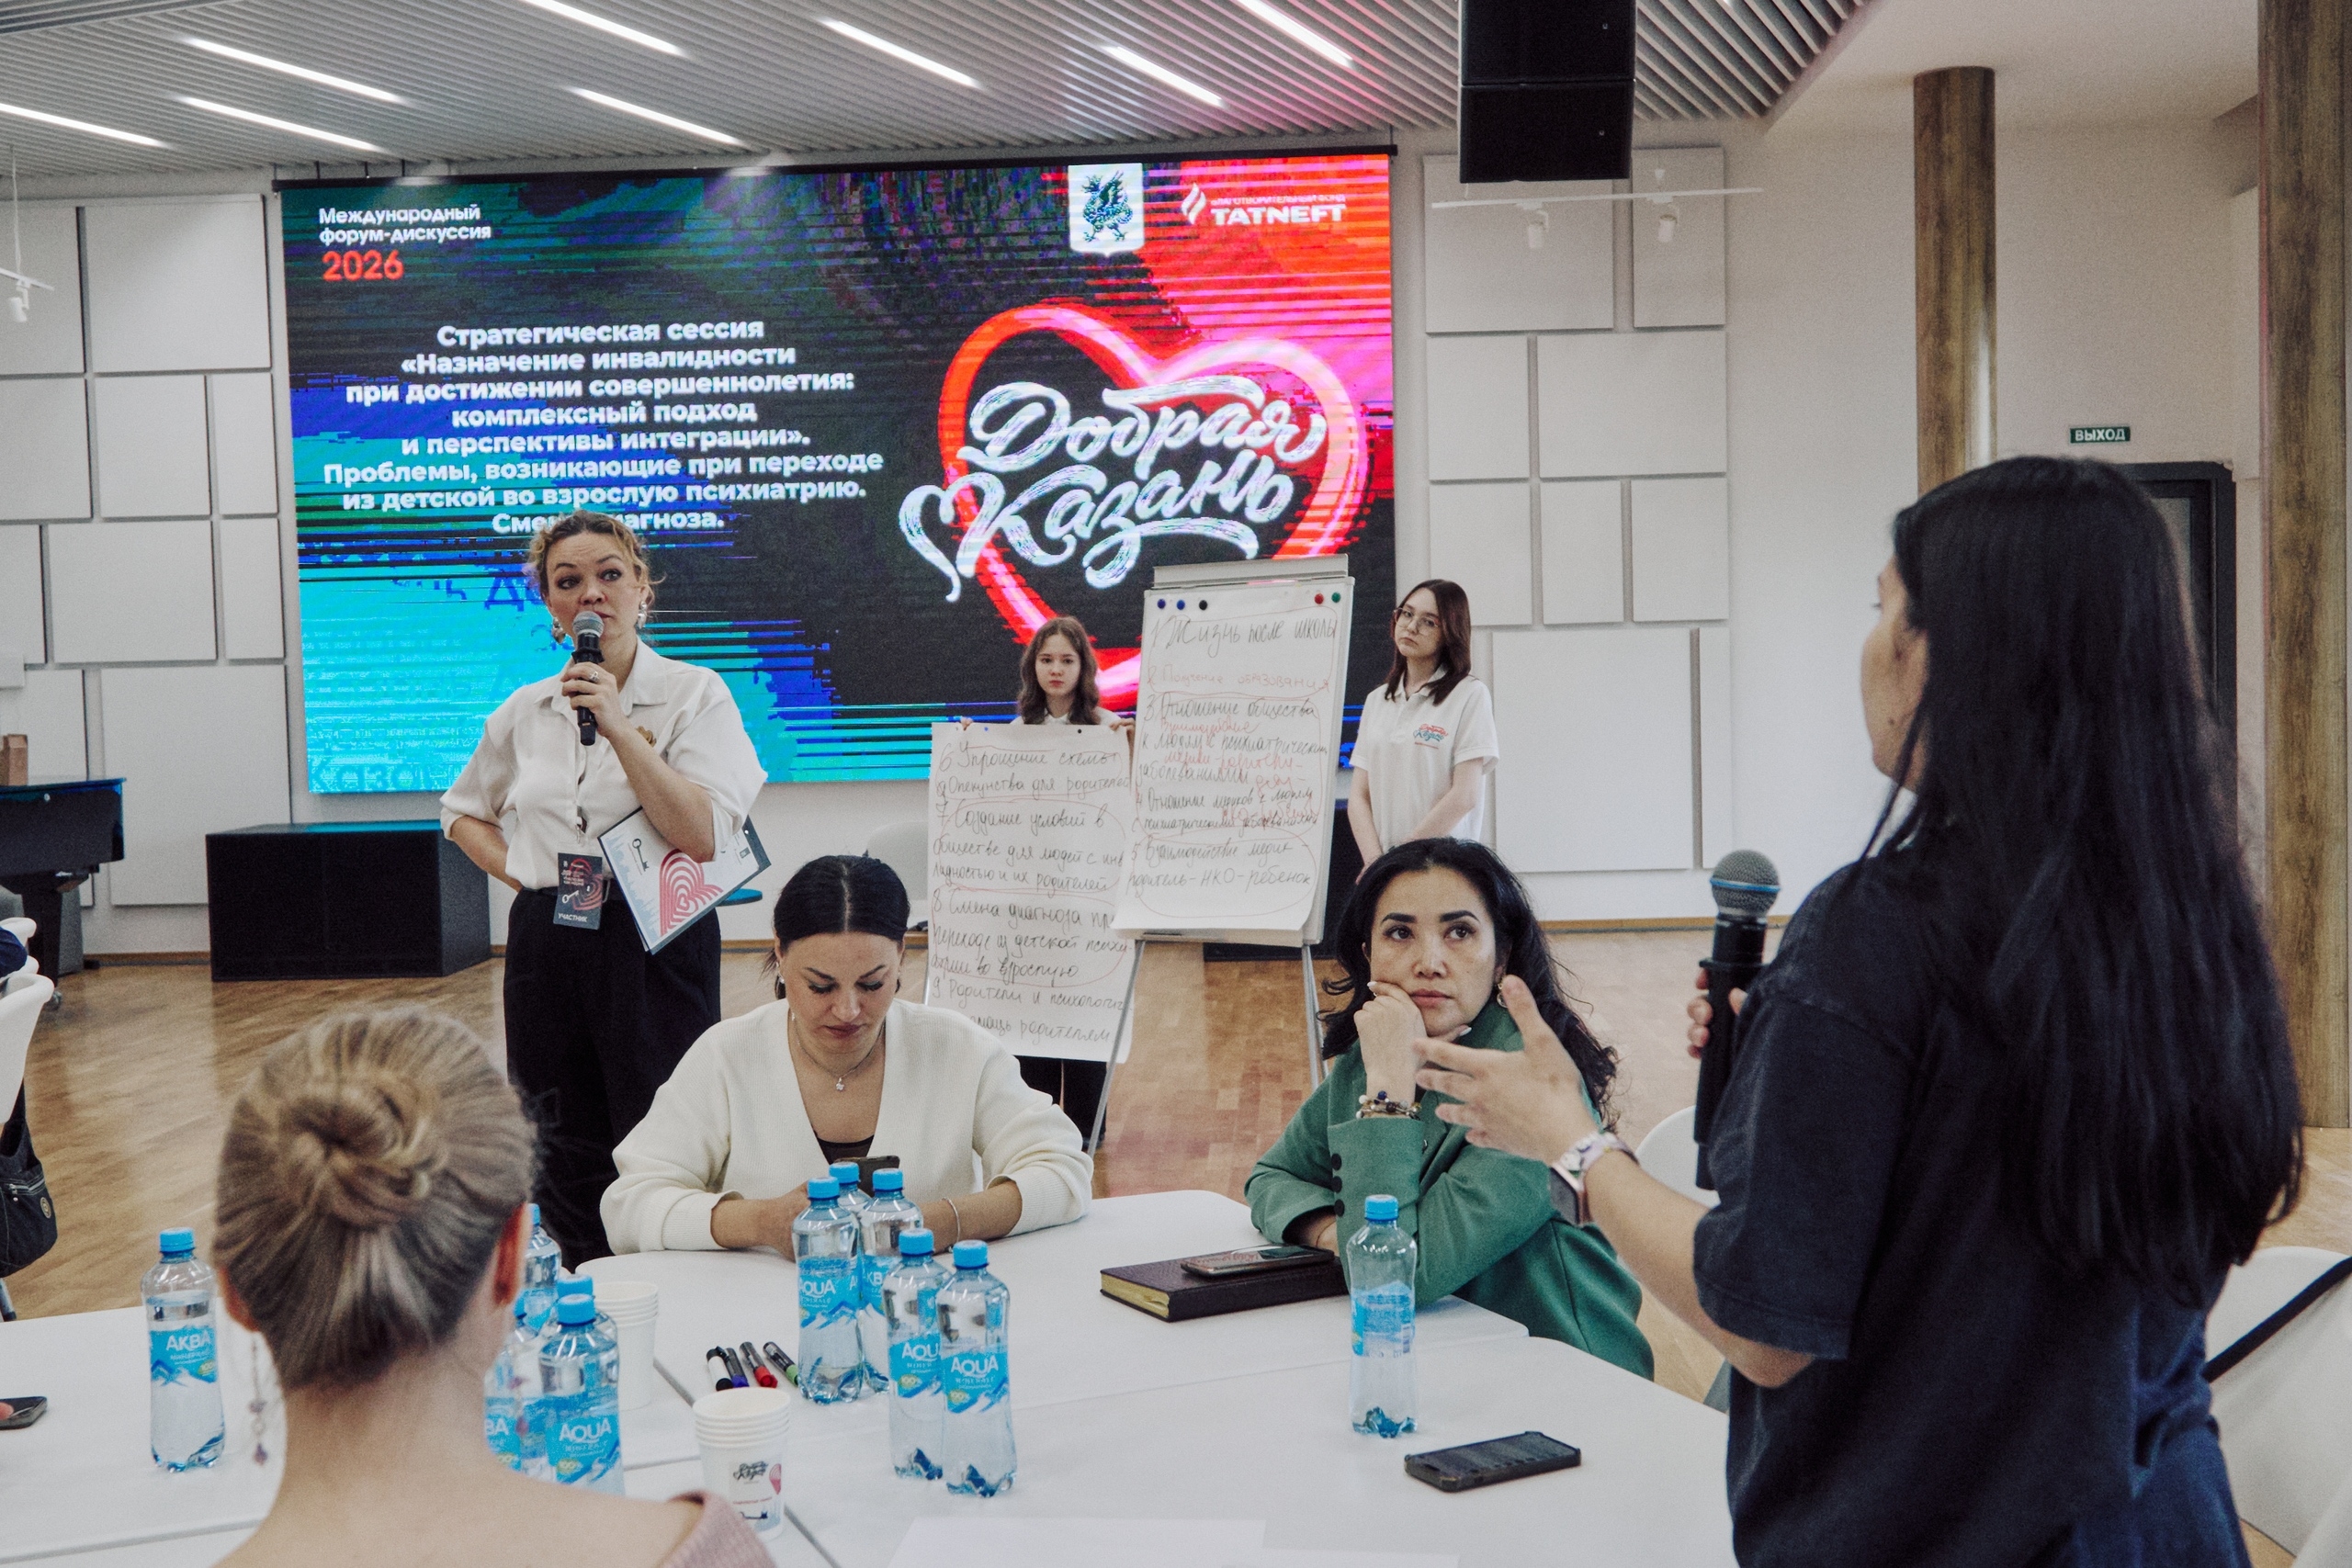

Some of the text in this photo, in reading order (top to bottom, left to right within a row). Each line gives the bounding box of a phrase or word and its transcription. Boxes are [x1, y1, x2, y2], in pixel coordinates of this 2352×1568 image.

[318, 203, 481, 224] Международный
[1210, 204, 1348, 226] TATNEFT
[318, 226, 492, 246] форум-дискуссия
[322, 249, 404, 281] 2026
[436, 321, 764, 350] Стратегическая сессия
[401, 347, 797, 375] «Назначение инвалидности
[345, 372, 854, 407] при достижении совершеннолетия:
[451, 400, 758, 427] комплексный подход
[957, 376, 1328, 479] Добрая
[2075, 429, 2126, 441] ВЫХОД
[401, 429, 811, 457] и перспективы интеграции».
[323, 453, 885, 489] Проблемы, возникающие при переходе
[343, 480, 867, 512] из детской во взрослую психиатрию.
[610, 512, 725, 530] агноза.
[899, 451, 1294, 603] Казань
[1248, 620, 1285, 643] после
[1294, 616, 1338, 640] школы
[1160, 692, 1240, 717] Отношение
[1032, 776, 1055, 800] для
[1007, 844, 1034, 866] для
[1036, 874, 1108, 898] родителей
[947, 888, 1000, 918] Смена
[1008, 903, 1083, 935] диагноза
[1014, 934, 1079, 959] детской
[901, 1342, 939, 1361] AQU
[950, 1354, 1000, 1378] AQUA
[559, 1417, 613, 1444] AQUA
